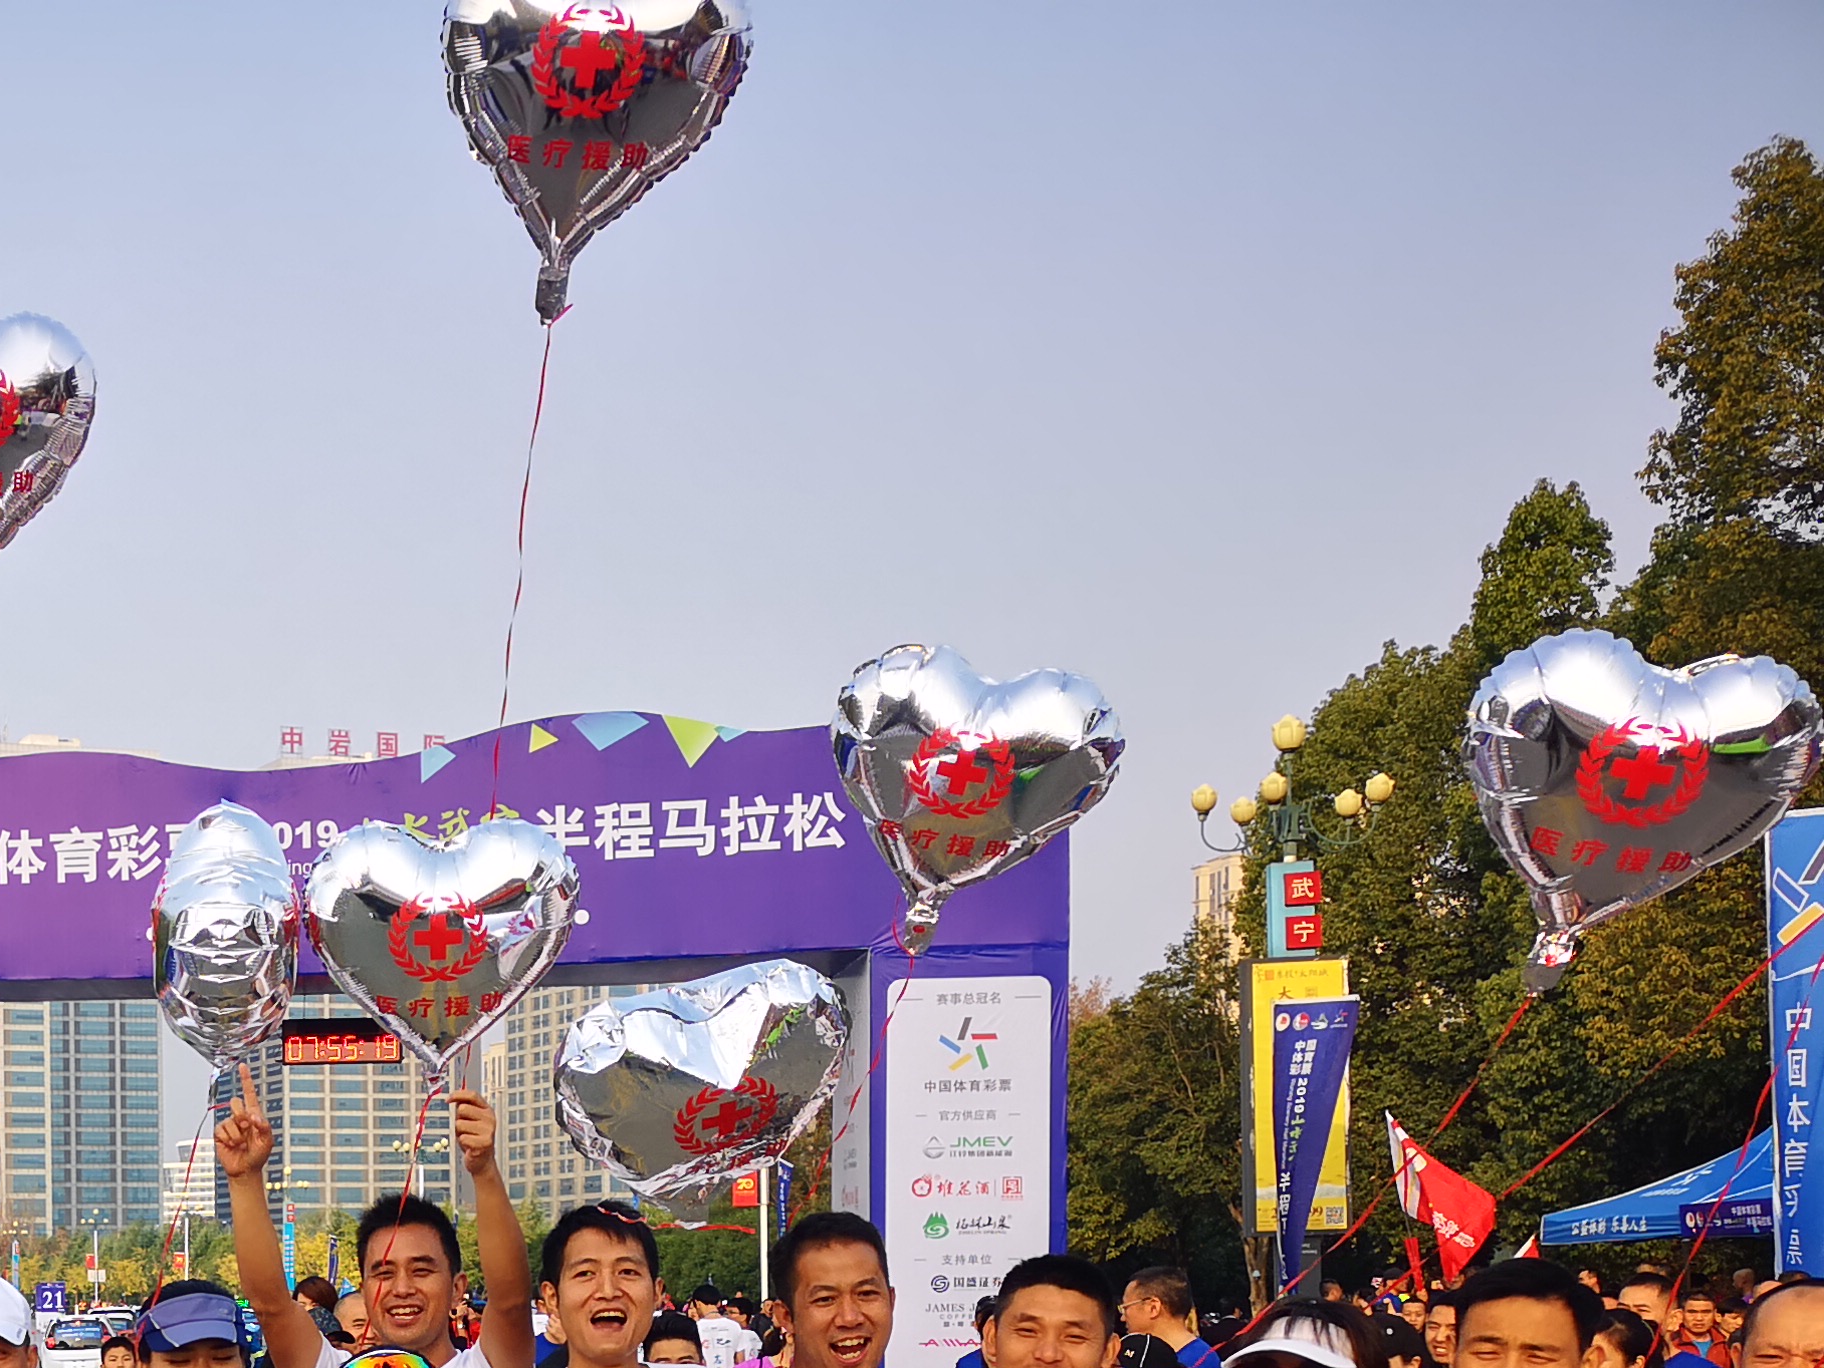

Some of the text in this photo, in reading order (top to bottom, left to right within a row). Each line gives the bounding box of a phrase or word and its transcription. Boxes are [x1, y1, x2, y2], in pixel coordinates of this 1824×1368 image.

[507, 134, 647, 170] 医疗援助
[276, 820, 340, 850] 019
[880, 818, 1011, 858] 医疗援助
[1530, 827, 1693, 873] 医疗援助
[1291, 878, 1316, 943] 武宁
[376, 991, 504, 1018] 医疗援助
[936, 991, 1002, 1006] 赛事总冠名
[924, 1078, 1012, 1094] 中国体育彩票
[949, 1135, 1013, 1147] JMEV
[42, 1290, 64, 1309] 21
[925, 1303, 965, 1313] JAMES
